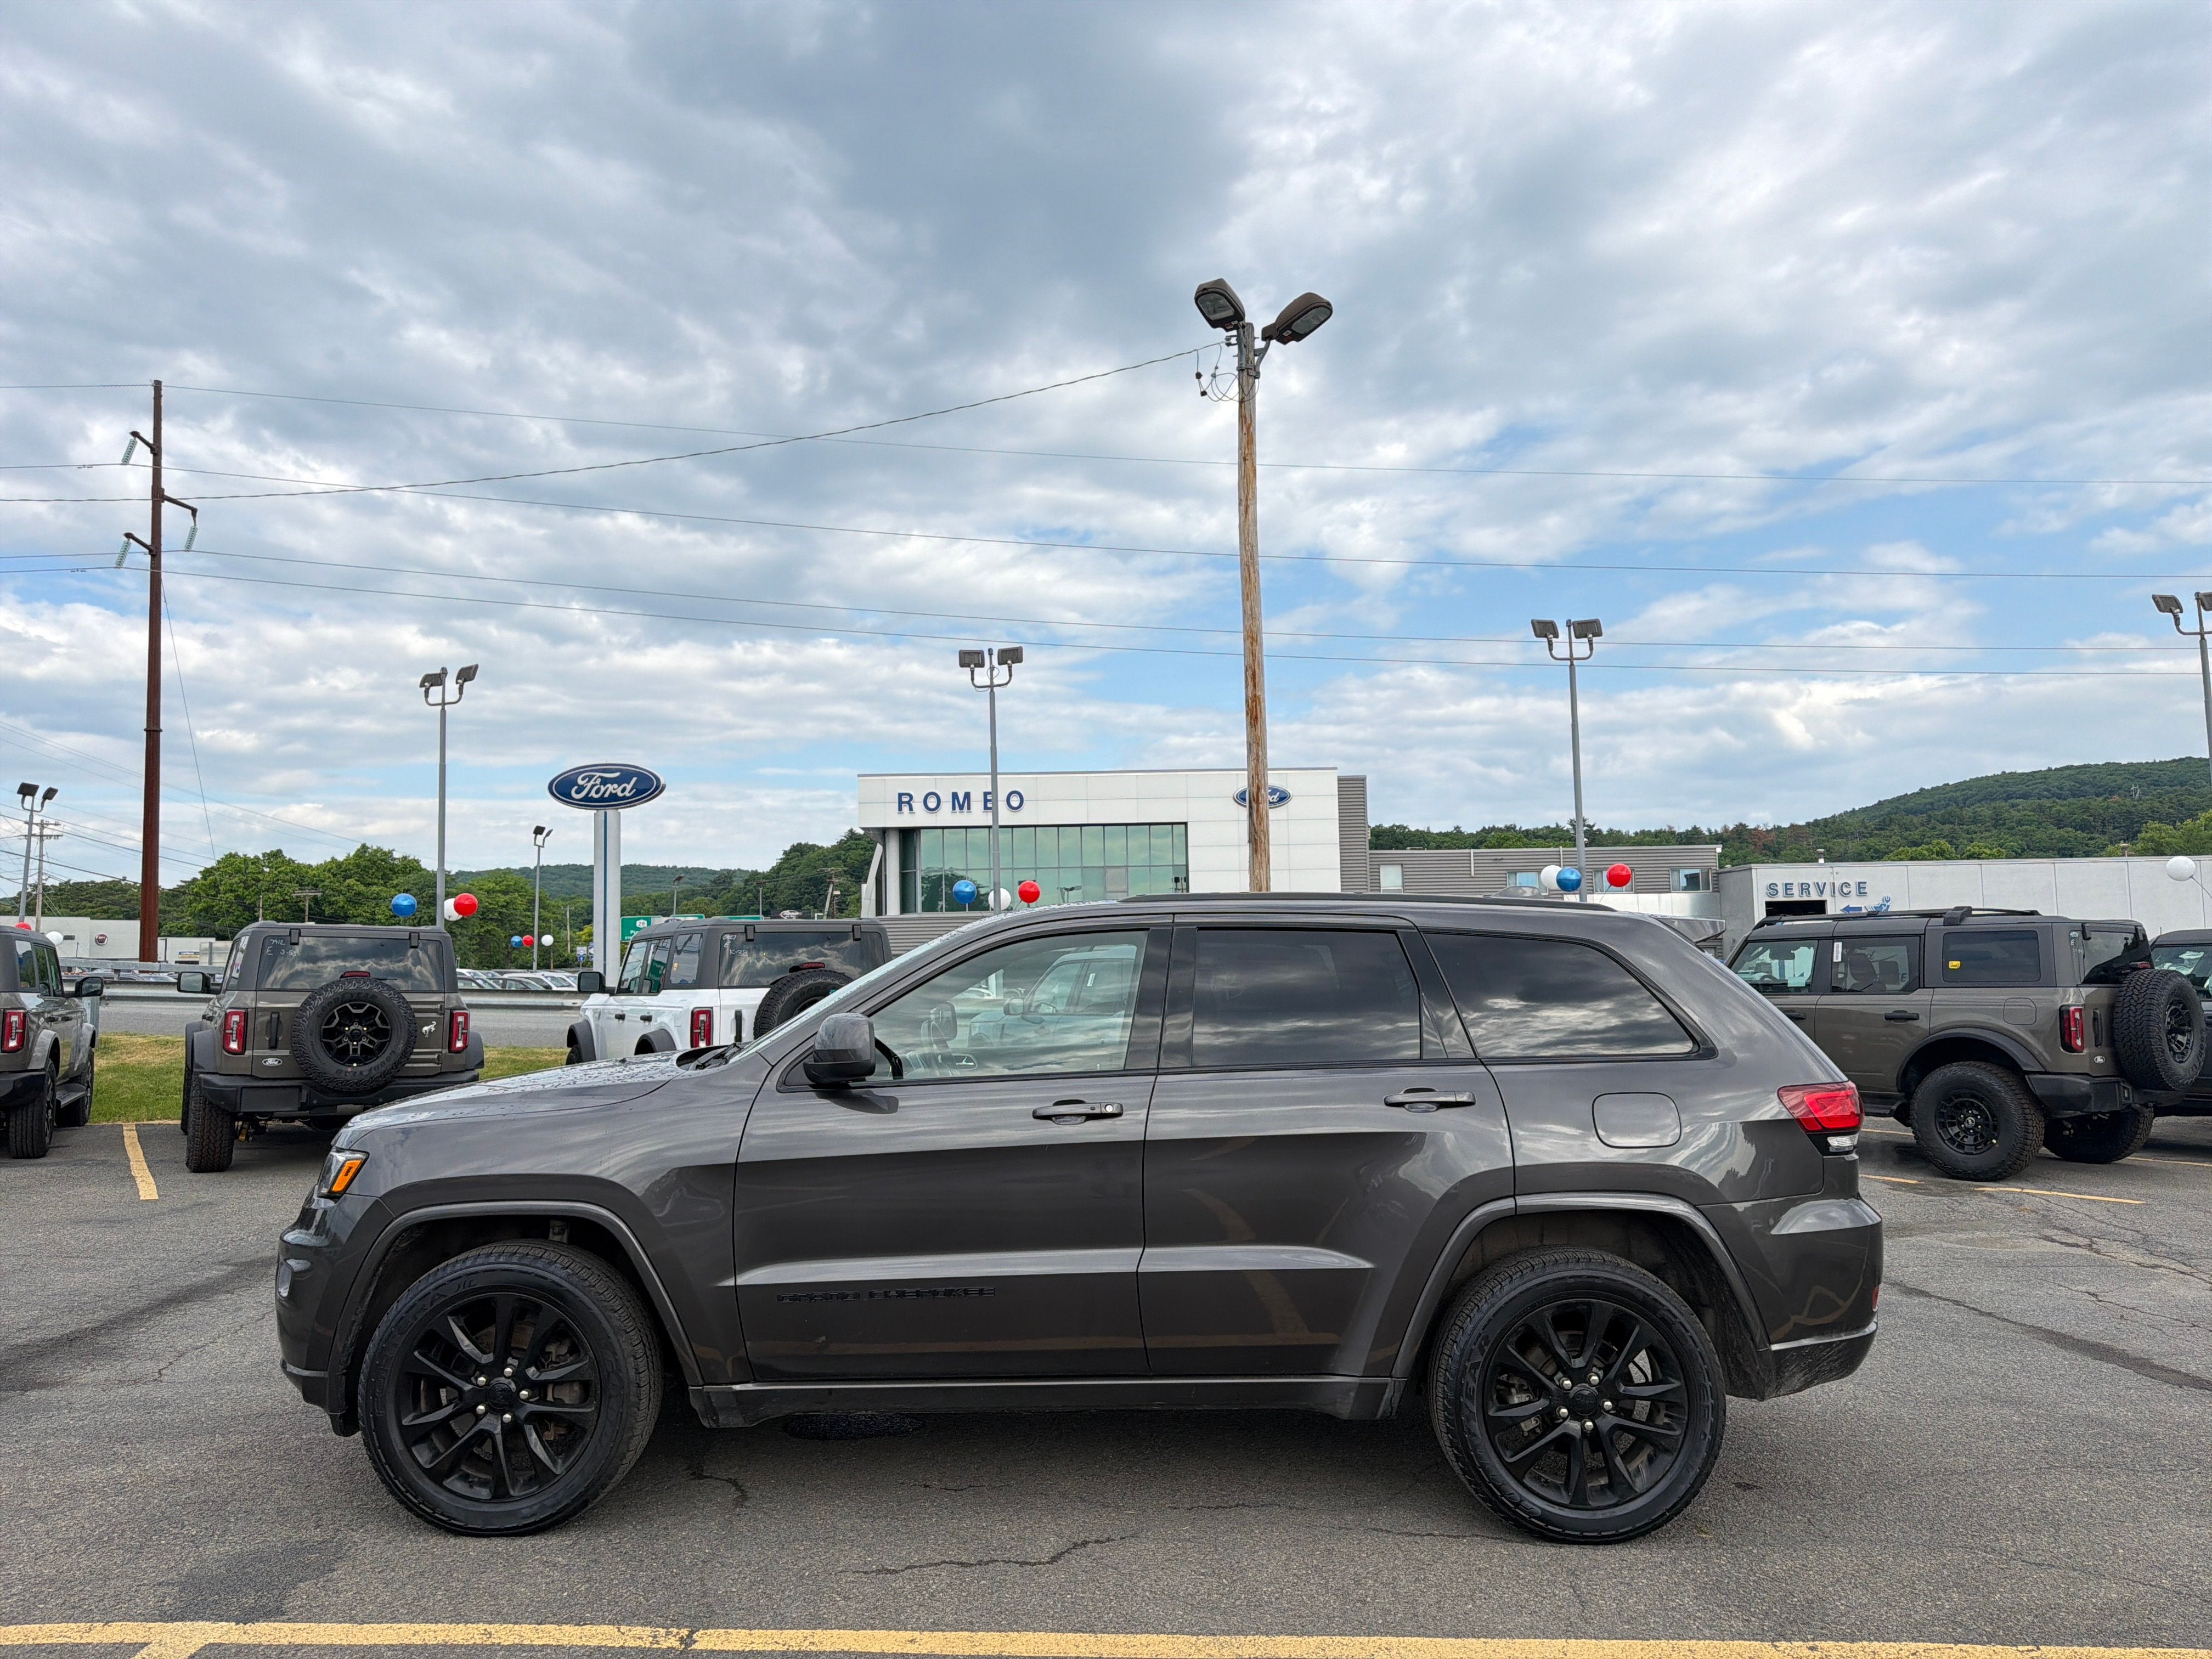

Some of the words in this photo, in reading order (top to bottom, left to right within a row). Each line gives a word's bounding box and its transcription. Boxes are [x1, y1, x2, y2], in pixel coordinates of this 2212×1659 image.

[571, 772, 637, 799] Ford
[897, 790, 1024, 813] ROMEO
[1767, 881, 1867, 896] SERVICE
[777, 1290, 860, 1303] GRAND
[868, 1287, 996, 1300] CHEROKEE
